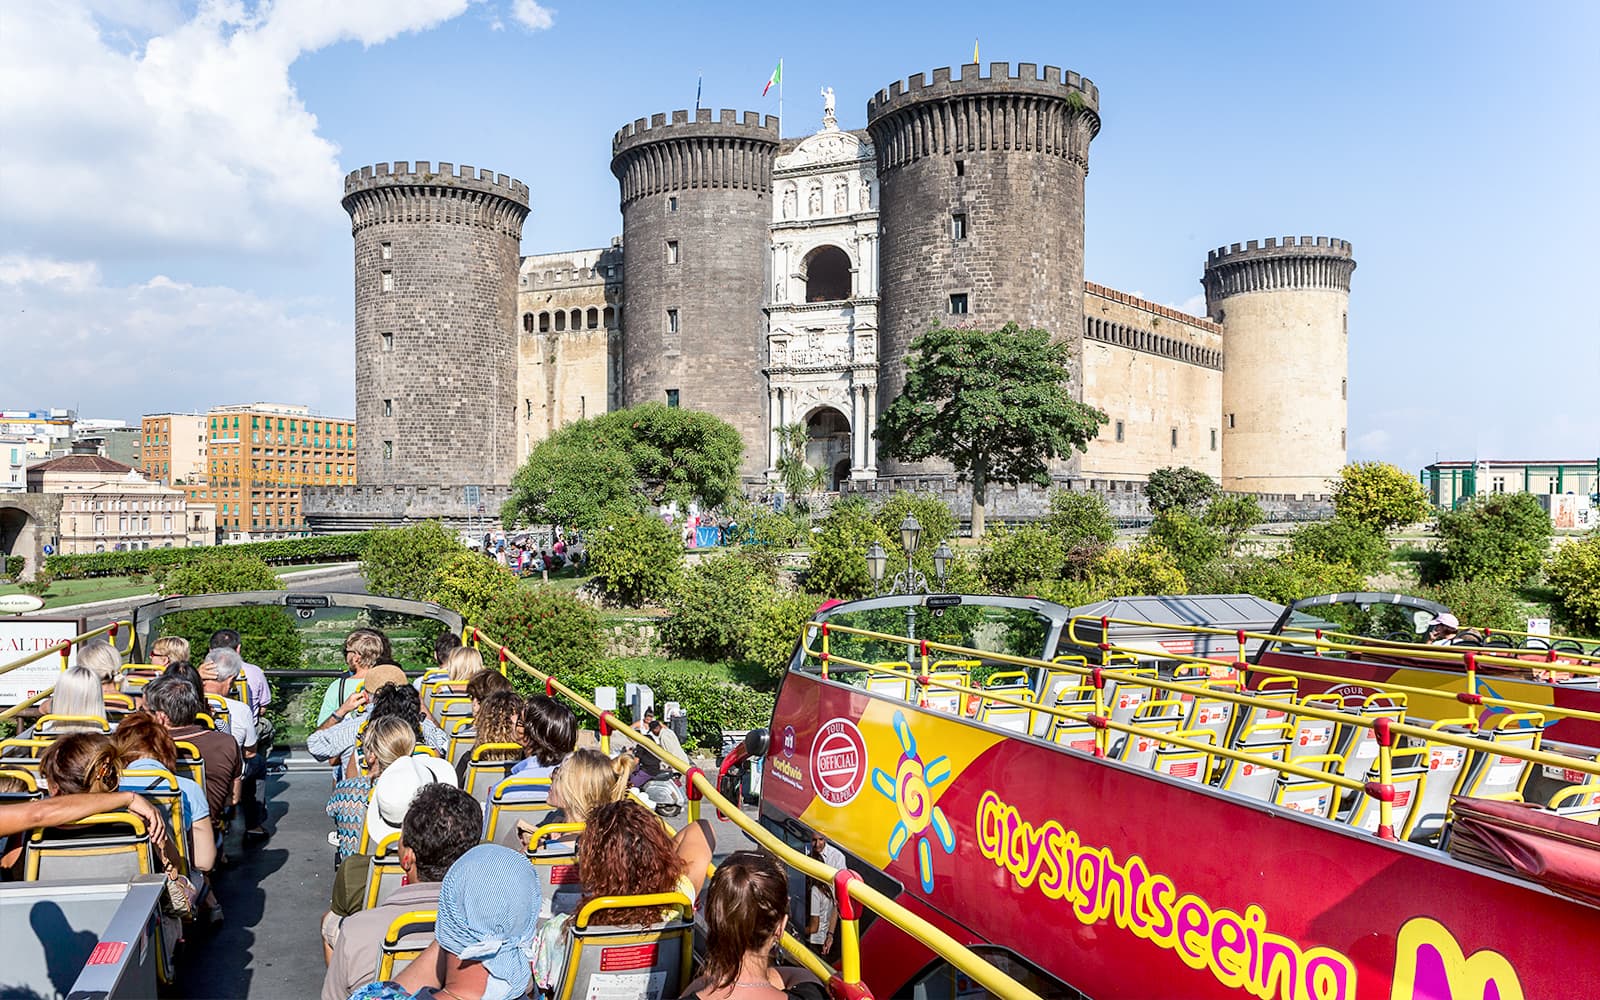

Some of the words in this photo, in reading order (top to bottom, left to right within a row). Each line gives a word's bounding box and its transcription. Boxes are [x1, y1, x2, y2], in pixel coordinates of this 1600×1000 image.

[1338, 687, 1363, 696] TOUR
[827, 722, 845, 735] TOUR
[820, 753, 856, 771] OFFICIAL
[822, 786, 832, 799] OF
[831, 783, 856, 802] NAPOLI
